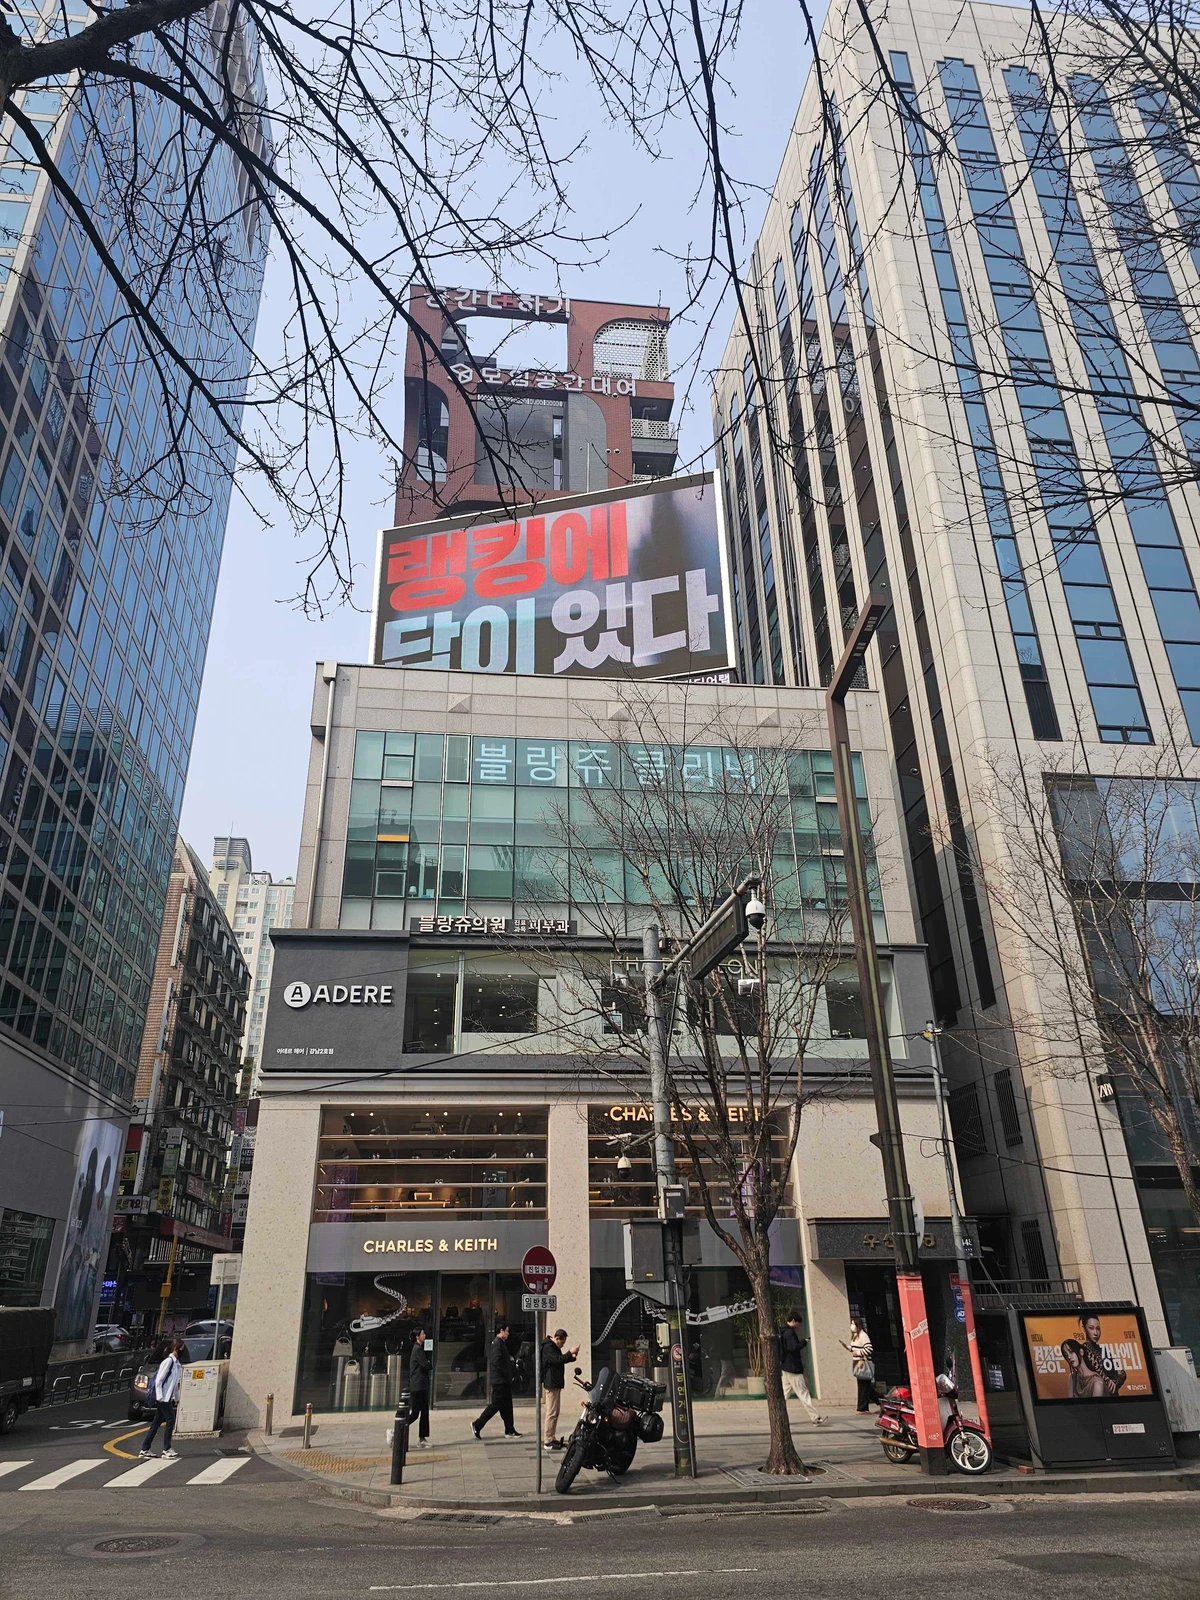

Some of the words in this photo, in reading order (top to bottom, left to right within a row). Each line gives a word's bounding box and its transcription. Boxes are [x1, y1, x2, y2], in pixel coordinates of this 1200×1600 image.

[386, 502, 629, 612] 랭킹에
[551, 568, 720, 675] 있다
[475, 743, 612, 785] 블랑쥬
[419, 914, 507, 933] 블랑쥬의원
[528, 918, 571, 934] 피부과
[312, 984, 394, 1004] ADERE
[698, 1106, 711, 1122] &
[363, 1239, 434, 1253] CHARLES
[438, 1239, 449, 1252] &
[453, 1238, 498, 1252] KEITH
[527, 1266, 553, 1274] 진입금지
[524, 1297, 555, 1309] 일방통행
